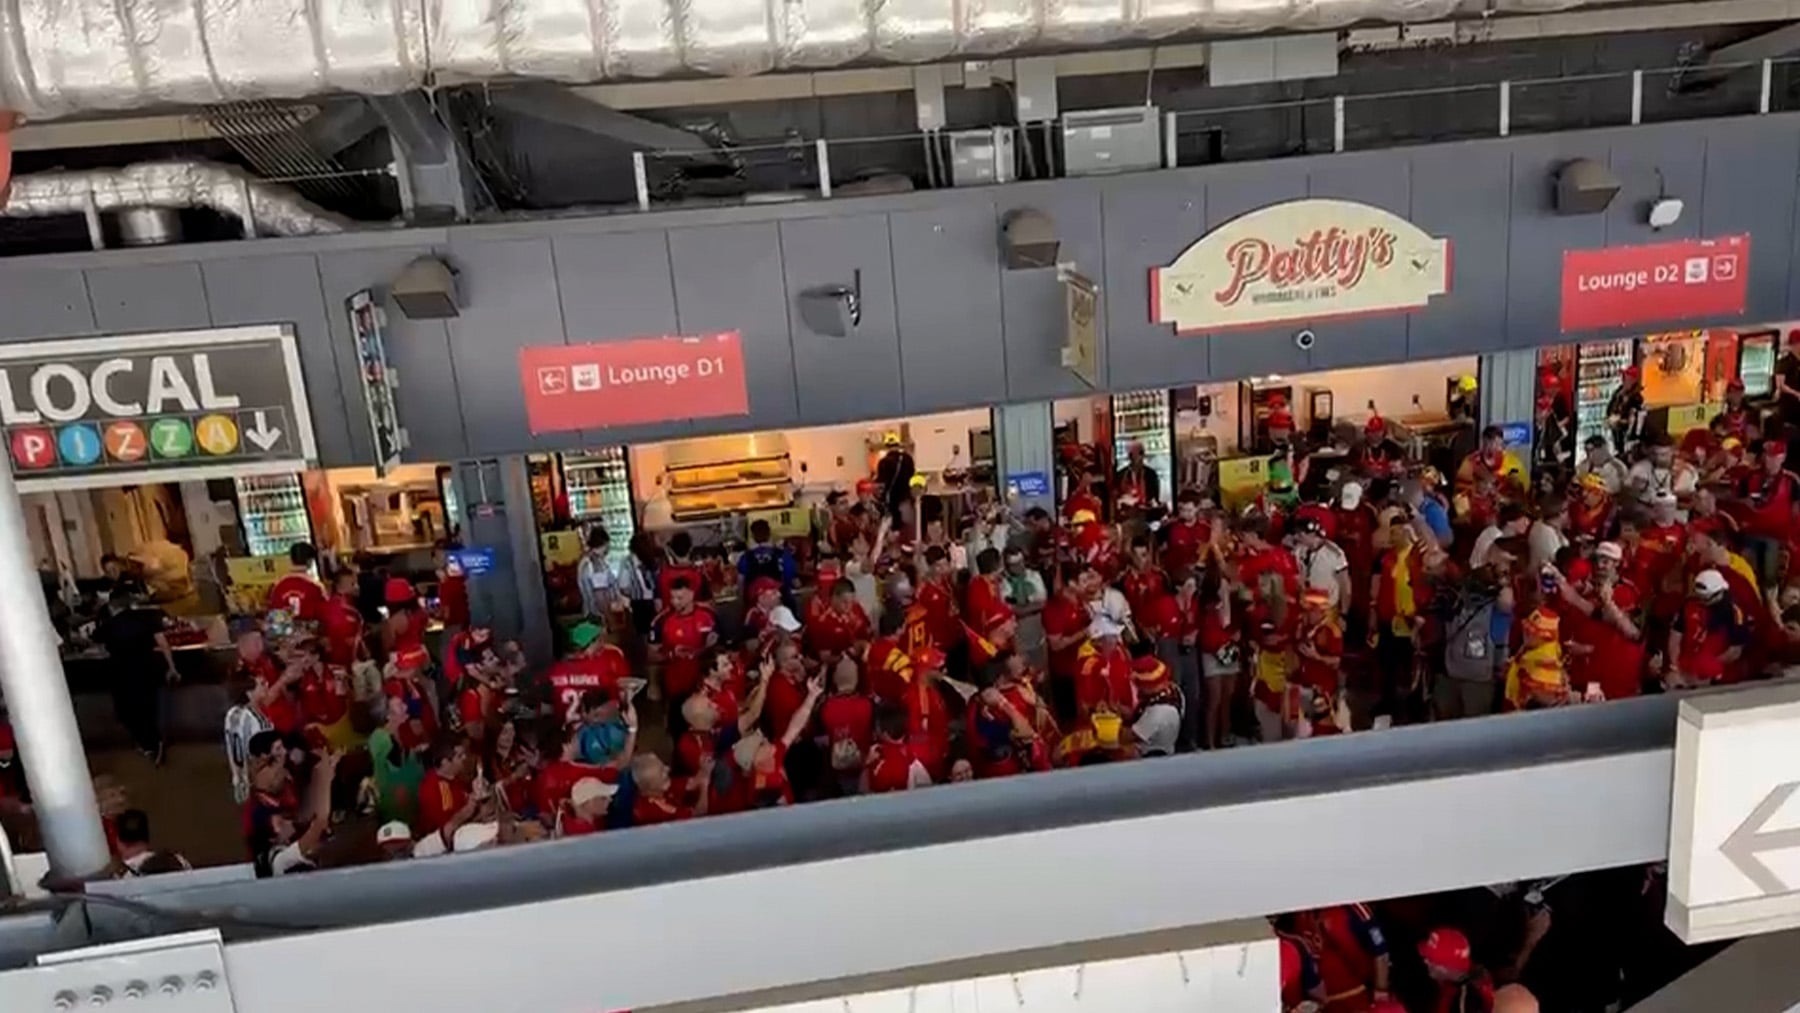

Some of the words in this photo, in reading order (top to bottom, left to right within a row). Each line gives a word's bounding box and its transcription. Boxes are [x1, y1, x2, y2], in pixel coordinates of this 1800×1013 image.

[1215, 226, 1398, 307] Patty's
[1578, 270, 1649, 292] Lounge
[1654, 263, 1679, 284] D2
[0, 353, 240, 425] LOCAL
[607, 363, 690, 386] Lounge
[696, 357, 725, 377] D1
[21, 421, 234, 464] PIZZA
